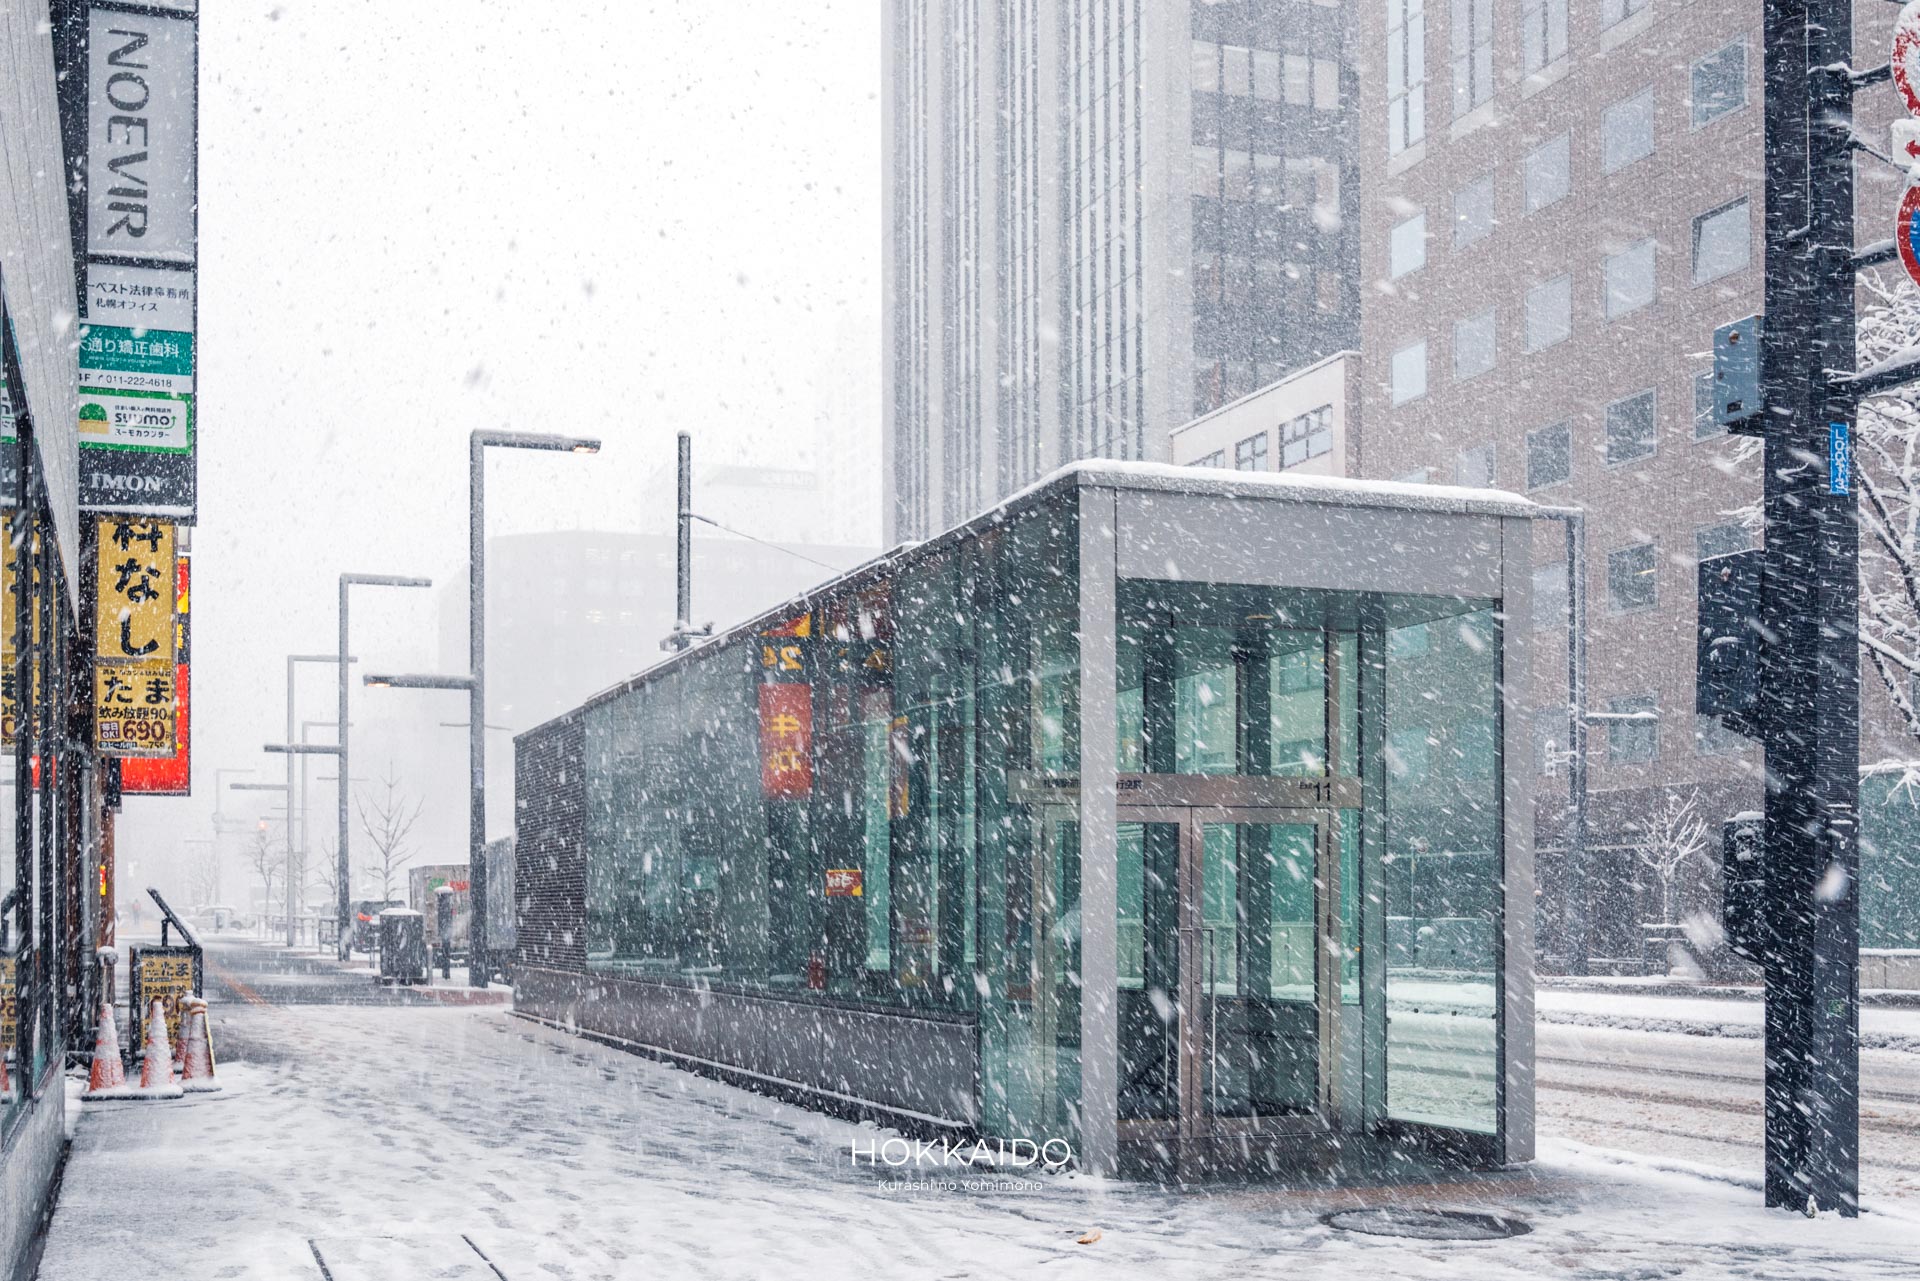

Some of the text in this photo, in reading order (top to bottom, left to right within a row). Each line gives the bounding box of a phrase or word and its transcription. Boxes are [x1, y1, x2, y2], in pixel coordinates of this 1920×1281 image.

[106, 28, 149, 237] NOEVIR
[95, 297, 158, 312] 札幌オフィス
[103, 676, 170, 704] たま
[102, 731, 119, 739] OK!
